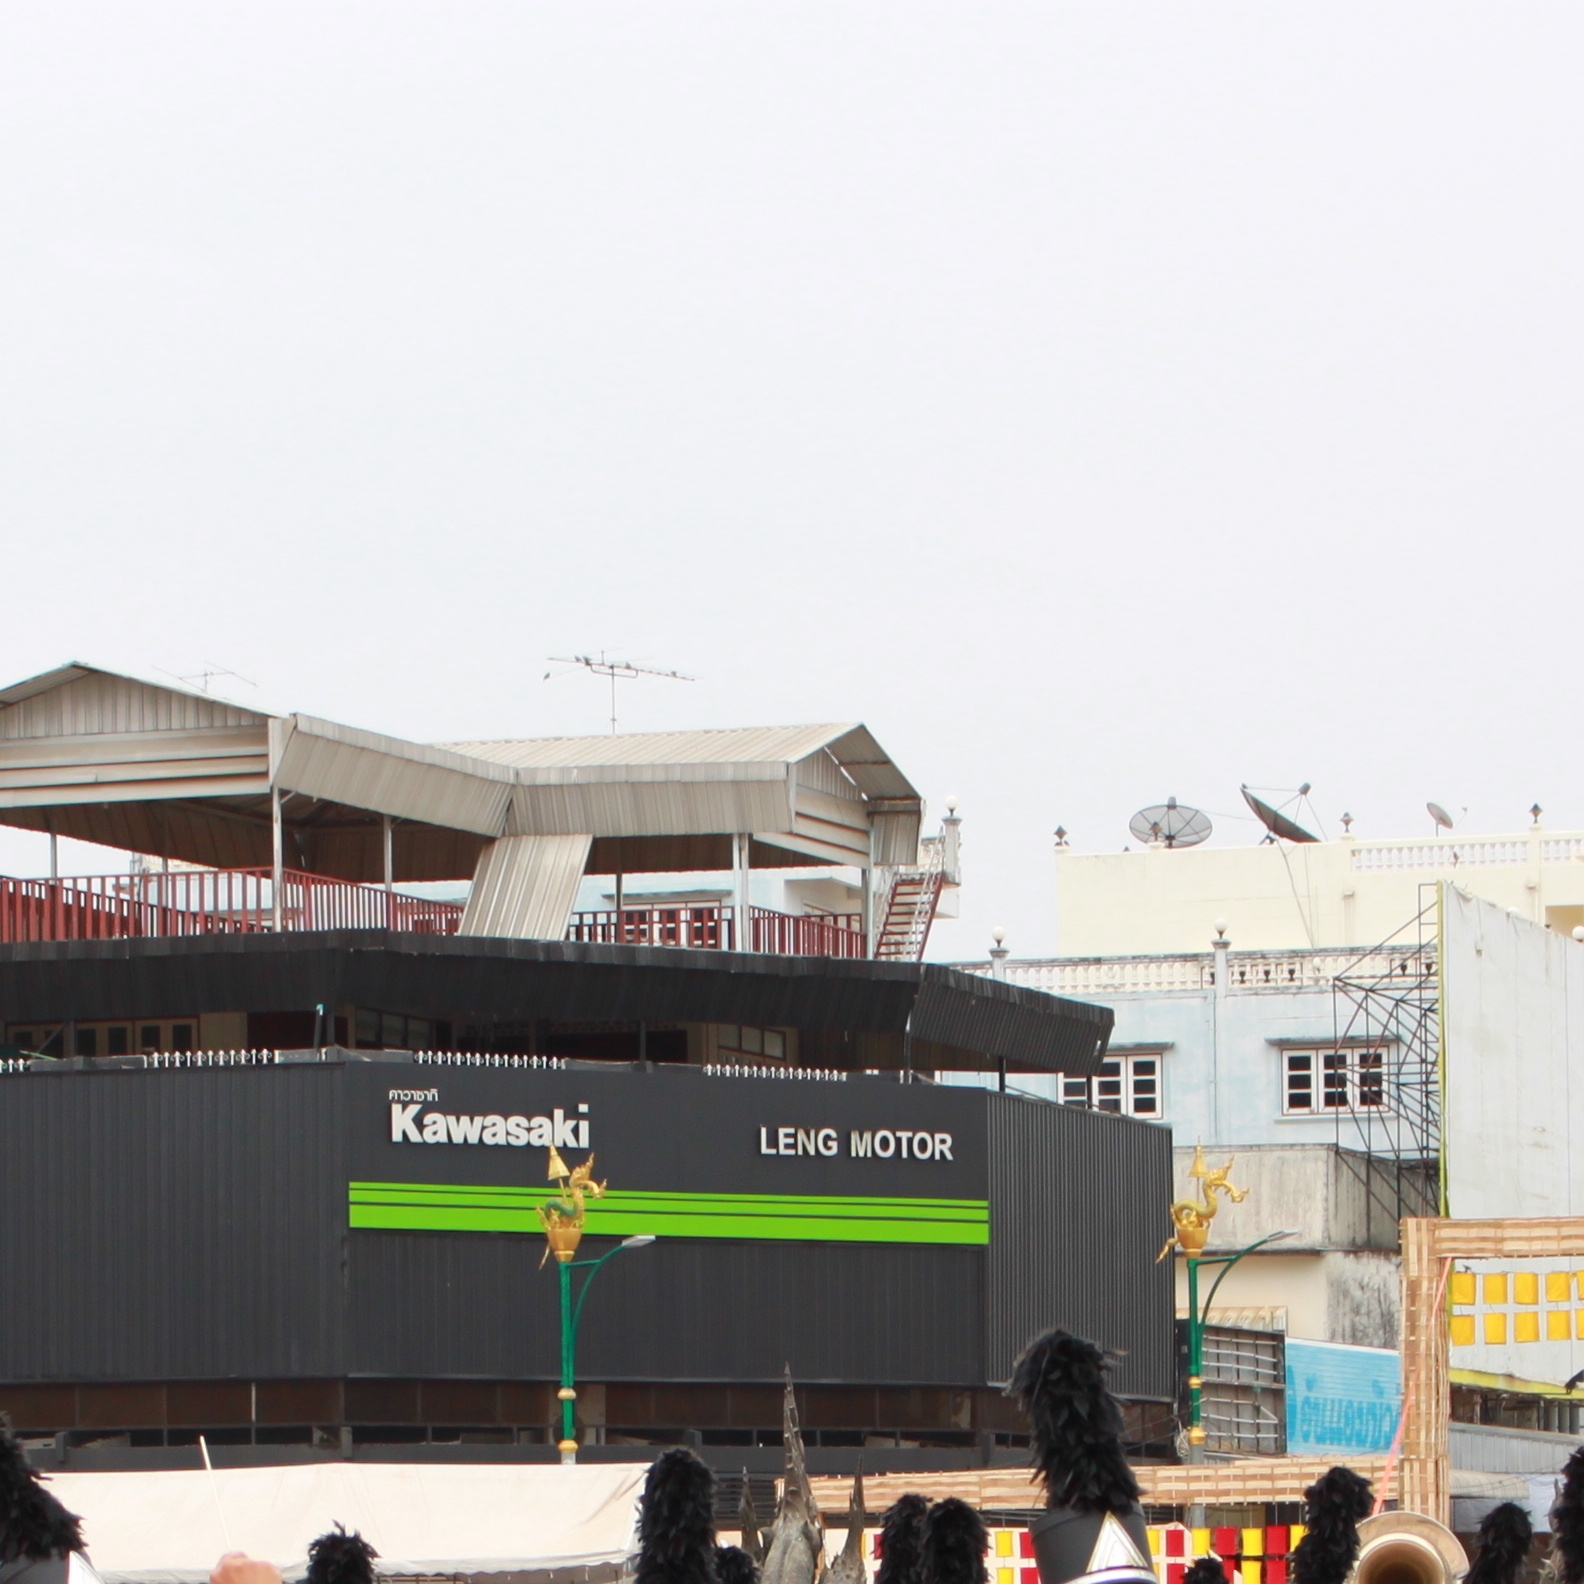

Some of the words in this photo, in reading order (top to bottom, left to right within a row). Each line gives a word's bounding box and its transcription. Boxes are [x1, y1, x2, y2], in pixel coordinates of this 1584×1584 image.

[389, 1089, 439, 1102] คาวาซากิ
[391, 1103, 590, 1148] Kawasaki
[760, 1126, 839, 1157] LENG
[850, 1129, 954, 1161] MOTOR
